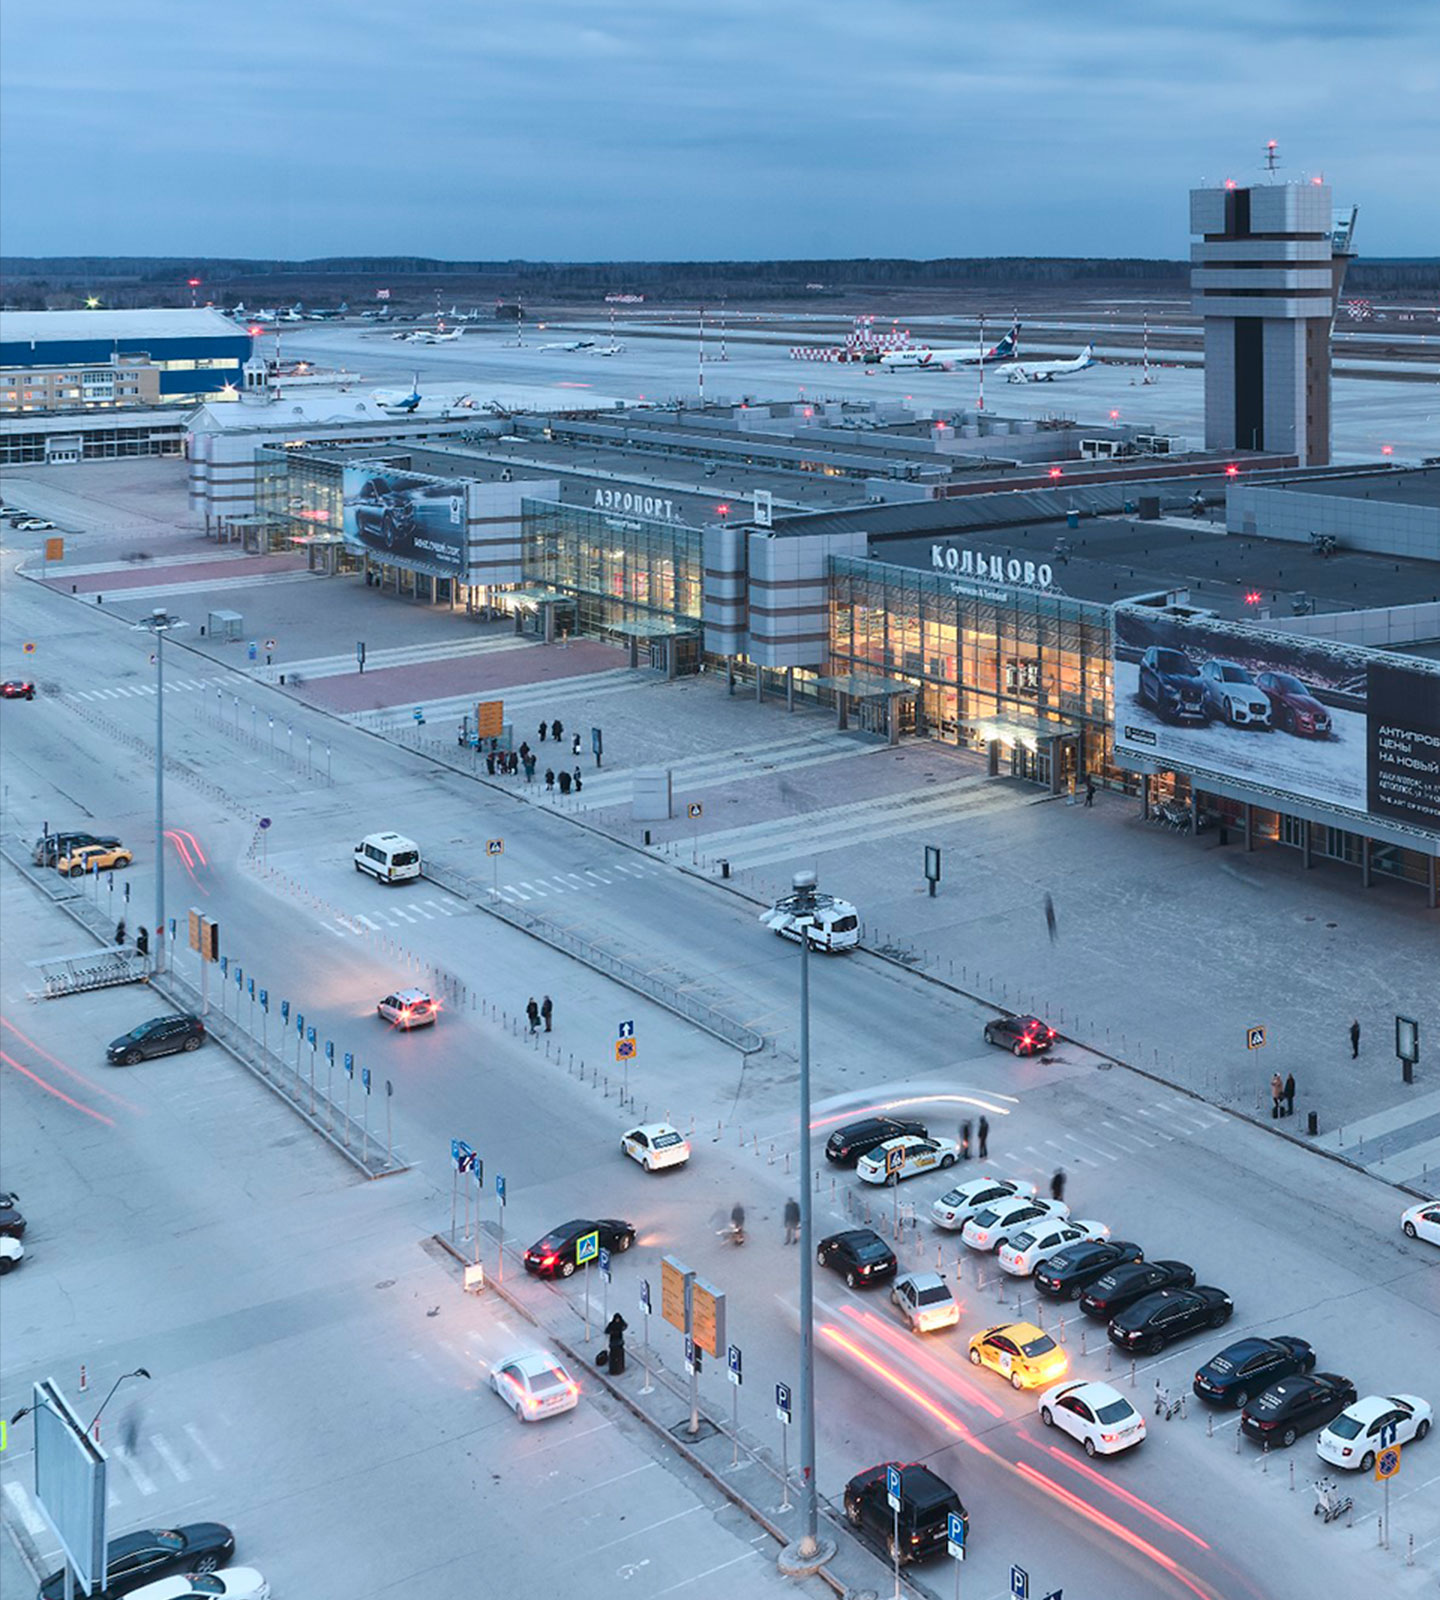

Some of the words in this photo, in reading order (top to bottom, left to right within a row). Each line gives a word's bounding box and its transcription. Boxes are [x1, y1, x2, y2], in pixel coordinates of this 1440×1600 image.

[595, 489, 673, 518] АЭРОПОРТ
[932, 545, 1052, 588] КОЛЬЦОВО
[1379, 738, 1411, 753] ЦЕНЫ
[1379, 751, 1395, 763] НА
[1397, 754, 1439, 774] НОВЫЙ
[891, 1472, 898, 1490] P
[951, 1518, 960, 1538] P
[1014, 1571, 1023, 1592] P
